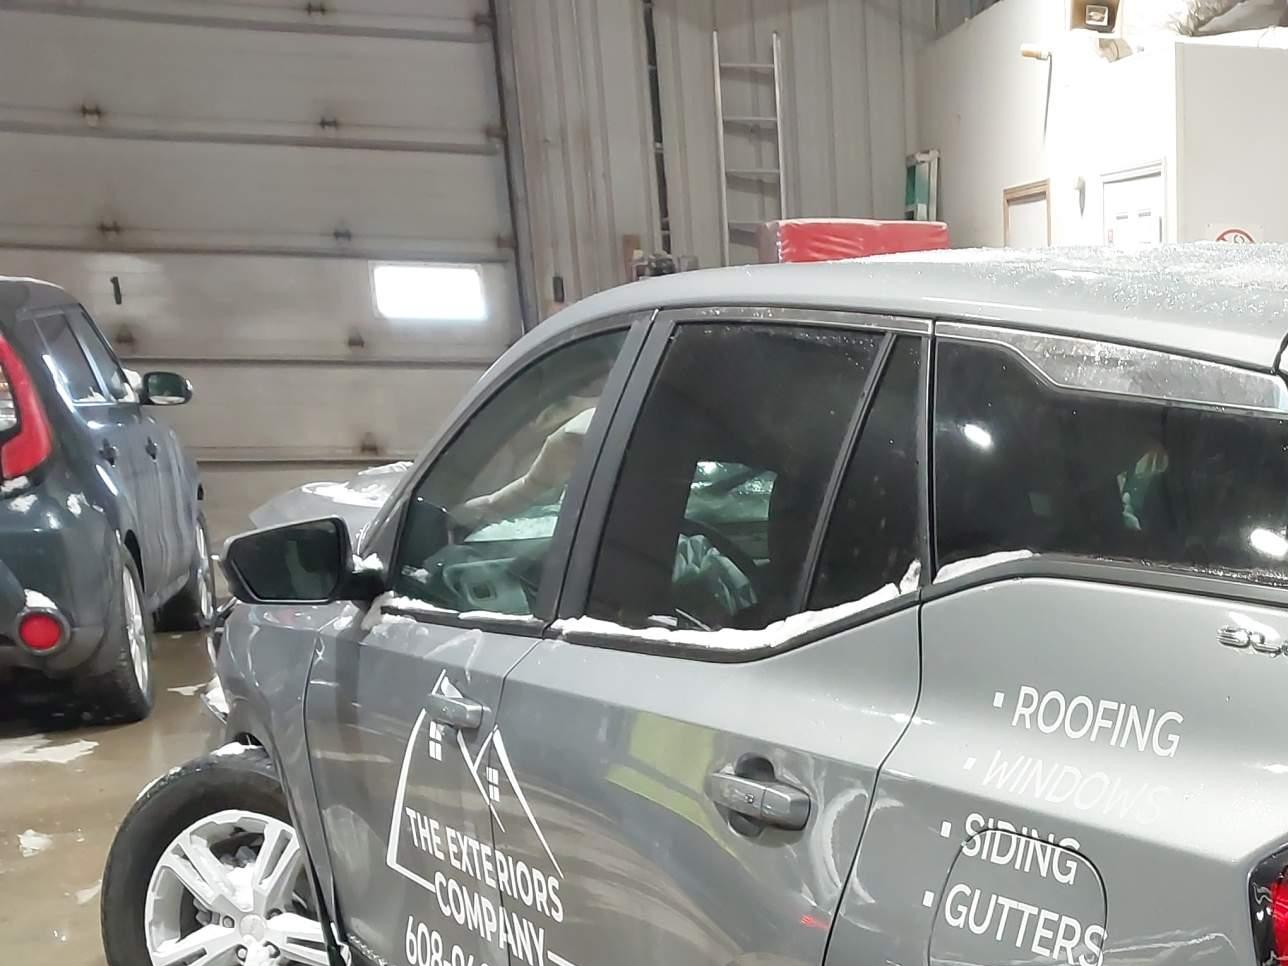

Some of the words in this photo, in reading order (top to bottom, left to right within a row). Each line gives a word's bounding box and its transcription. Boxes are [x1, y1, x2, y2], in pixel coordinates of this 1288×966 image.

[1011, 685, 1183, 757] ROOFING
[982, 750, 1171, 824] WINDOWS
[405, 807, 445, 862] THE
[445, 824, 564, 923] EXTERIORS
[961, 813, 1080, 885] SIDING
